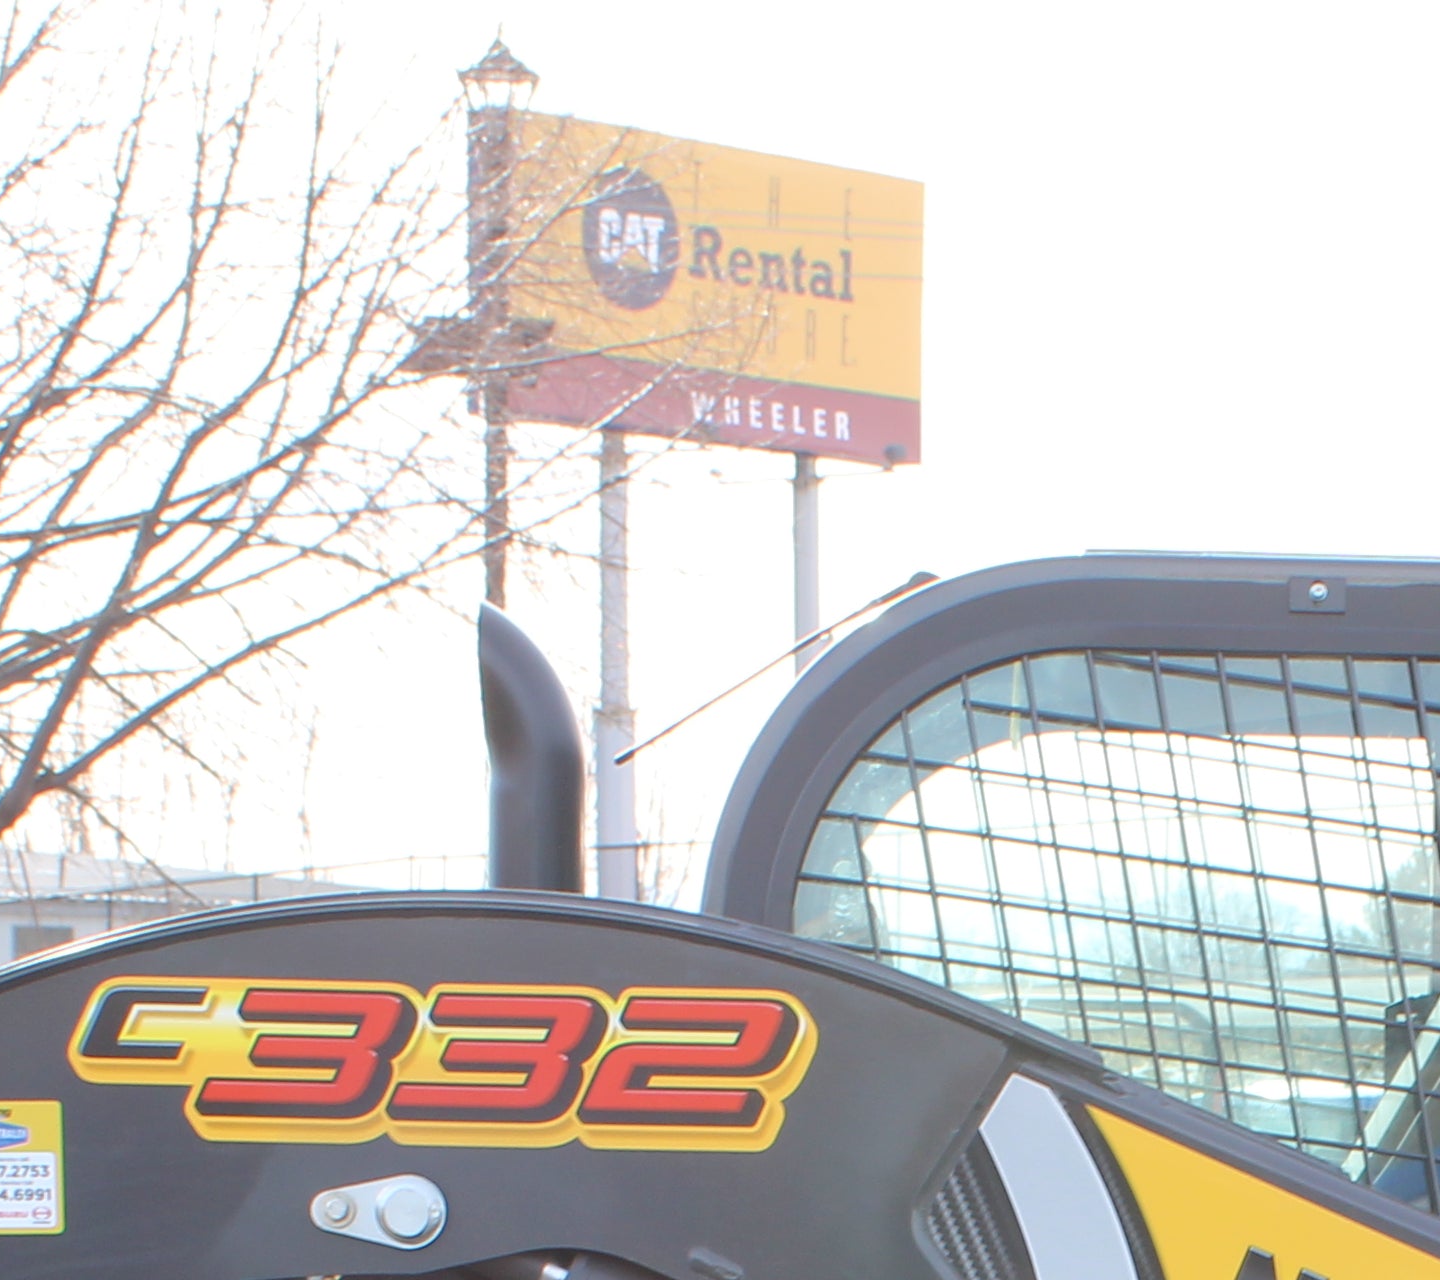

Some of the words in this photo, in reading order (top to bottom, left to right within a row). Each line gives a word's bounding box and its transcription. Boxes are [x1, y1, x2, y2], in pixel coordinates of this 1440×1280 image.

[598, 208, 665, 273] CAT
[688, 225, 854, 302] Rental
[690, 391, 851, 441] WHEELER
[73, 978, 812, 1135] C332
